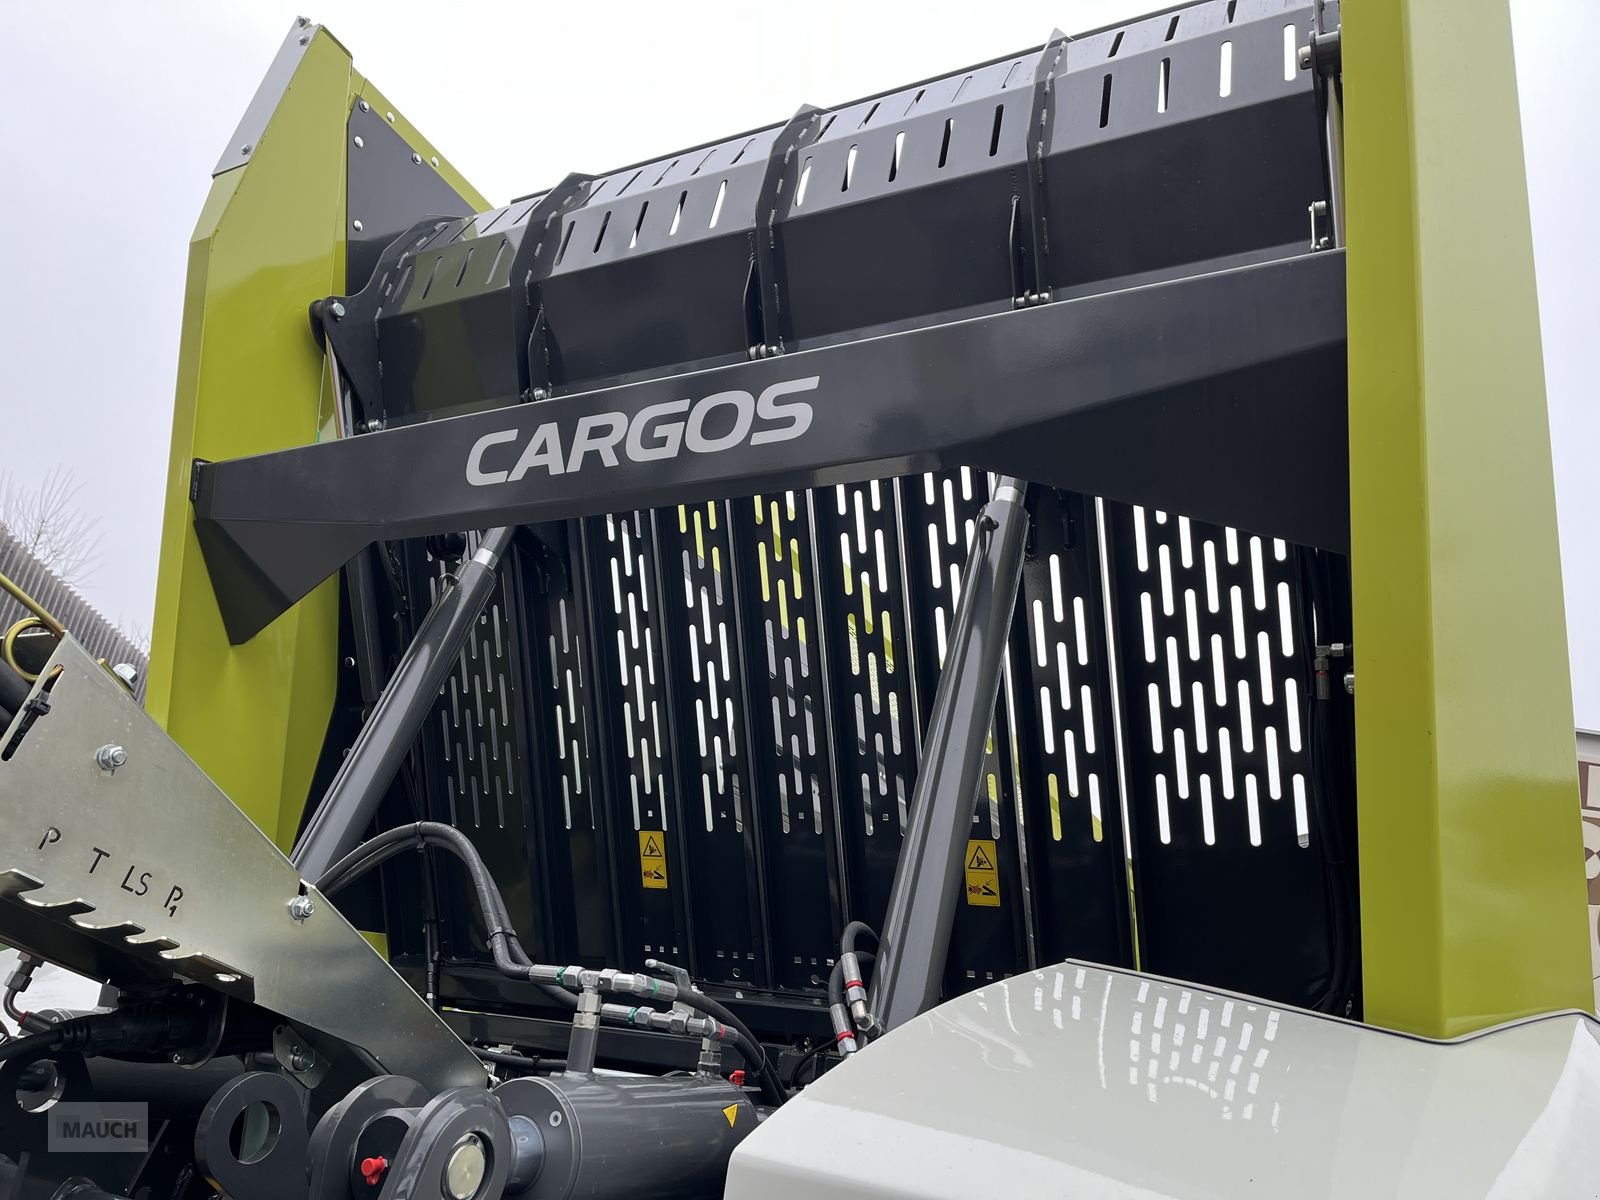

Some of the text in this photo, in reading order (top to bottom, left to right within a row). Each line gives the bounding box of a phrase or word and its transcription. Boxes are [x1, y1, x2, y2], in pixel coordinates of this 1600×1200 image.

[466, 376, 820, 486] CARGOS
[38, 826, 62, 850] P
[89, 847, 111, 874] T
[120, 865, 152, 896] LS
